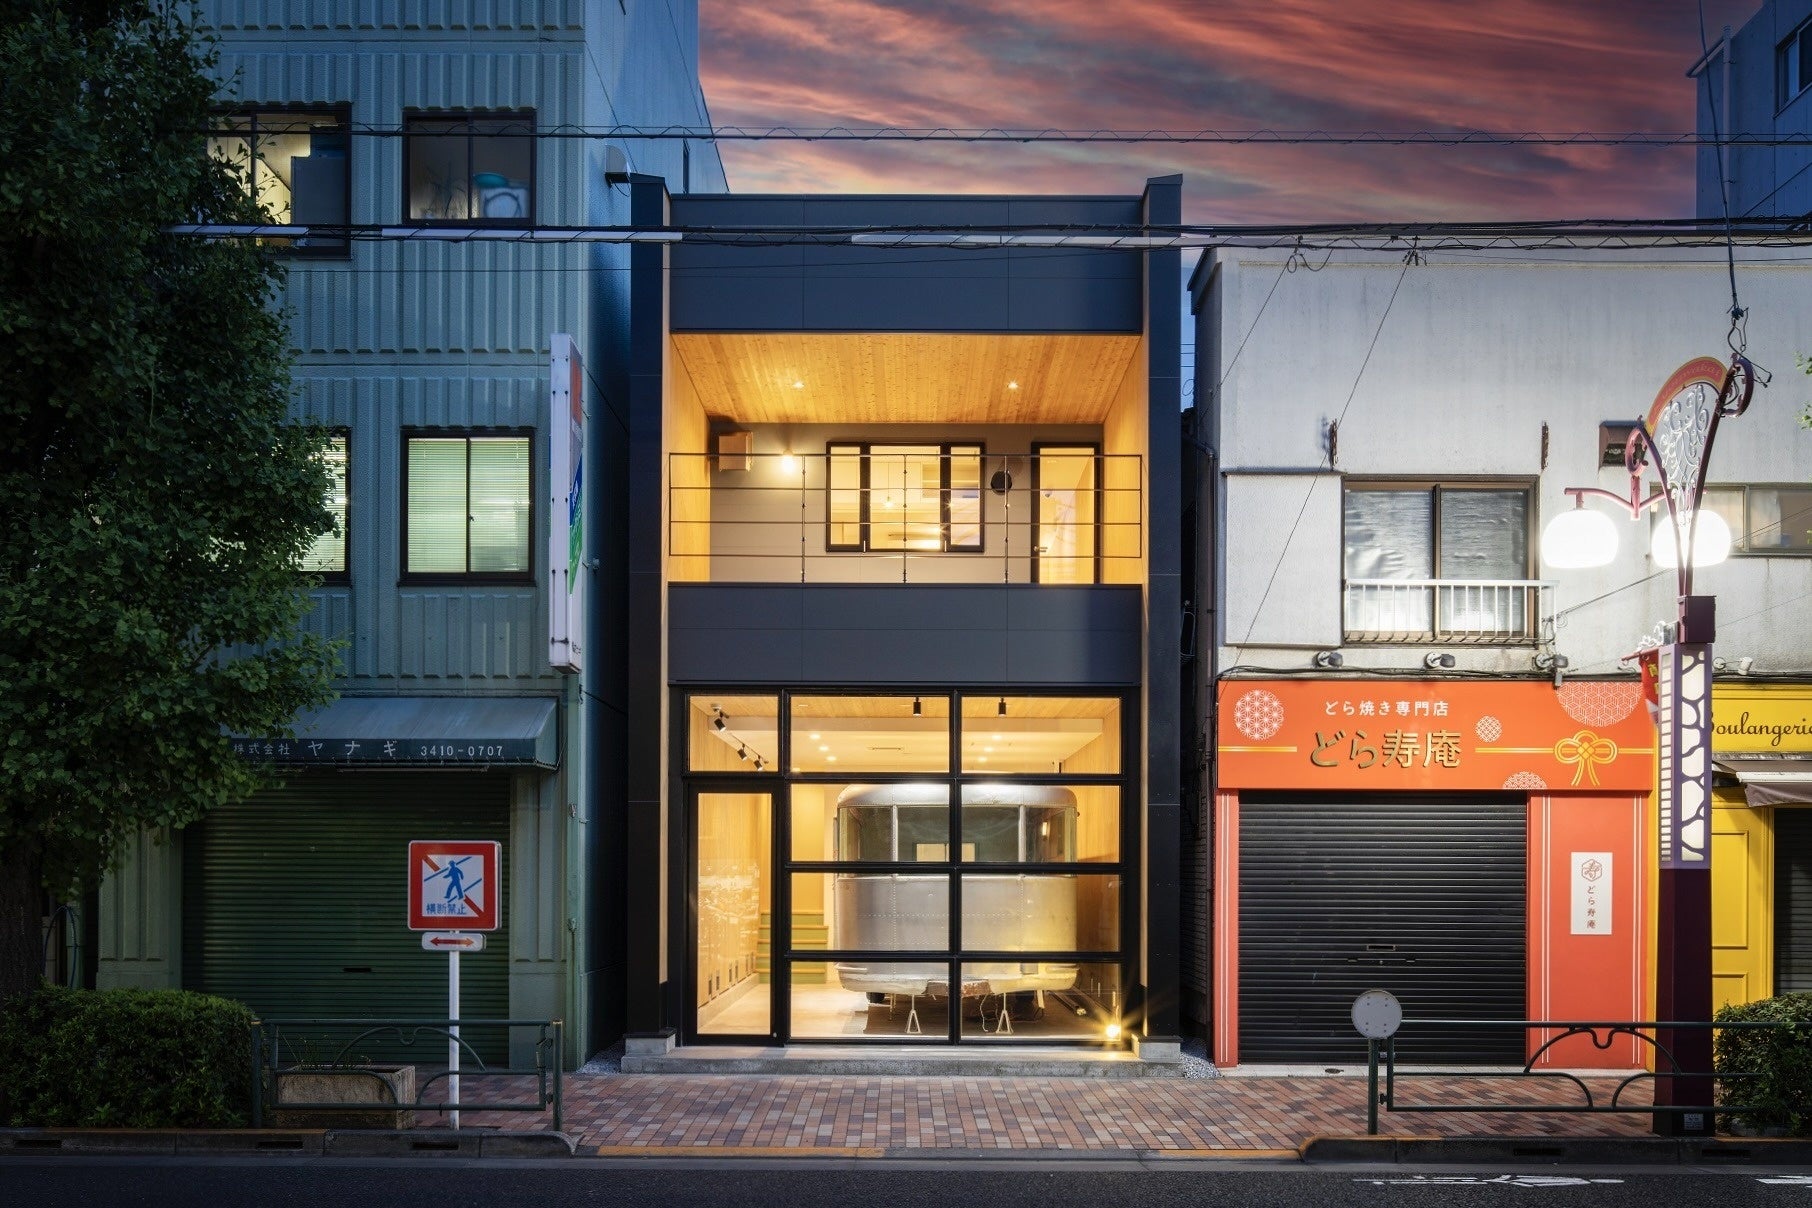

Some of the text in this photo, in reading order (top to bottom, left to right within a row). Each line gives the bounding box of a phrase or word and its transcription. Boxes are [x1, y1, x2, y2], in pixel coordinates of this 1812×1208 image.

[1325, 700, 1449, 717] どら焼き専門店
[1711, 711, 1812, 747] oulangeri
[233, 740, 504, 757] 株式会社 ヤナギ 3410-0707
[1311, 729, 1462, 769] どら寿庵
[426, 903, 467, 915] 横断禁止
[1586, 885, 1597, 929] どら寿庵
